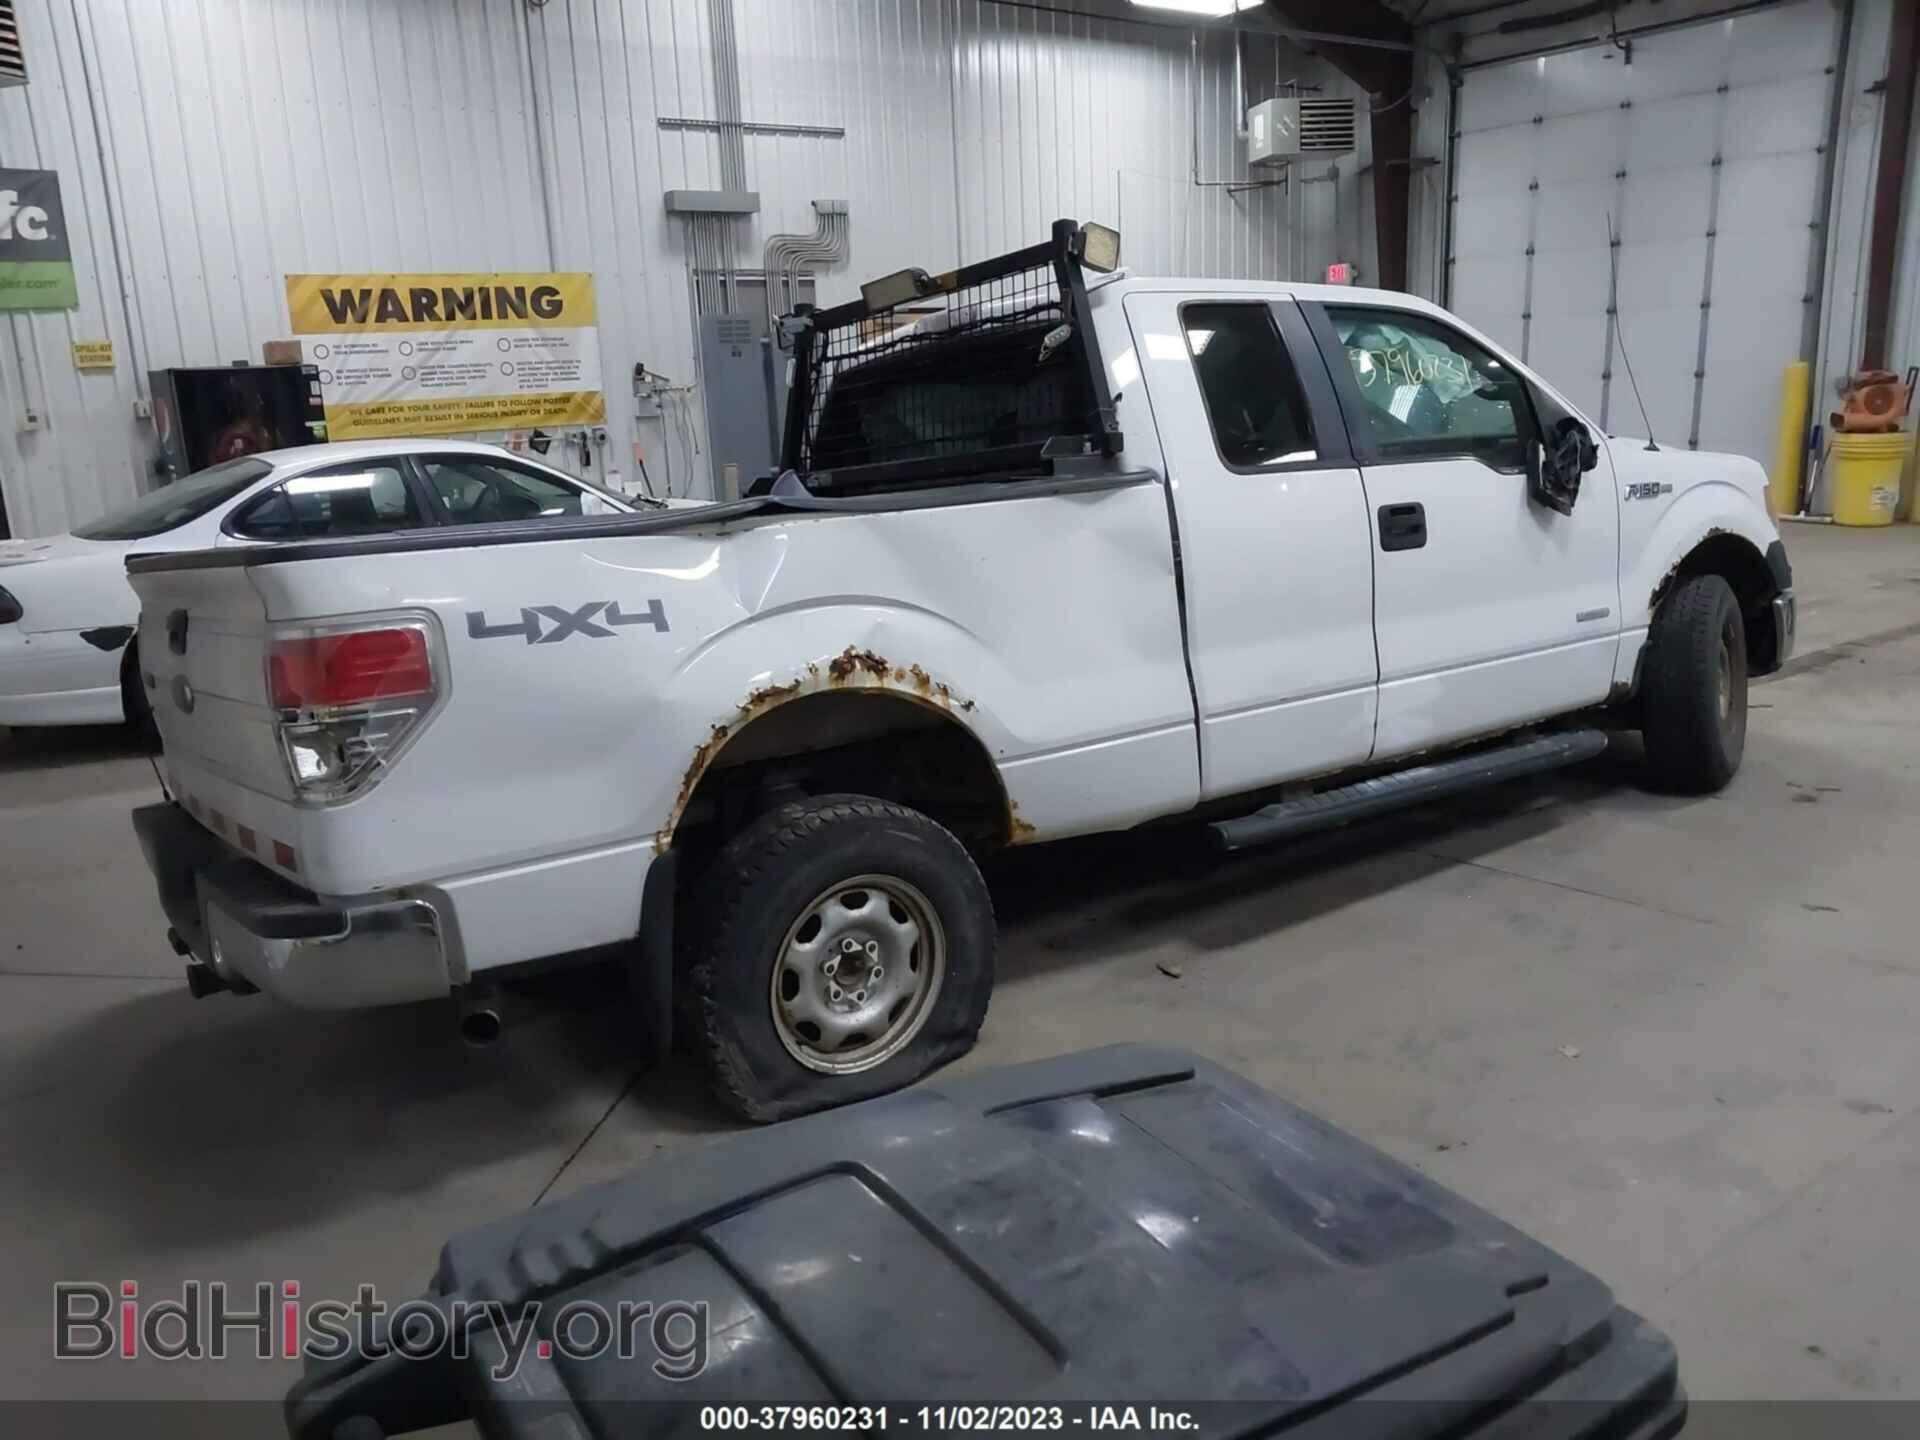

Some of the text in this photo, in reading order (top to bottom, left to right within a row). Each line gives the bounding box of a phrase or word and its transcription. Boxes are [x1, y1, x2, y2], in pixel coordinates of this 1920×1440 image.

[320, 286, 564, 324] WARNING
[388, 404, 404, 413] FOR
[407, 403, 431, 412] YOUR
[464, 400, 495, 409] FAILURE
[497, 399, 508, 408] TO
[510, 398, 541, 407] FOLLOW
[465, 598, 671, 645] 4X4
